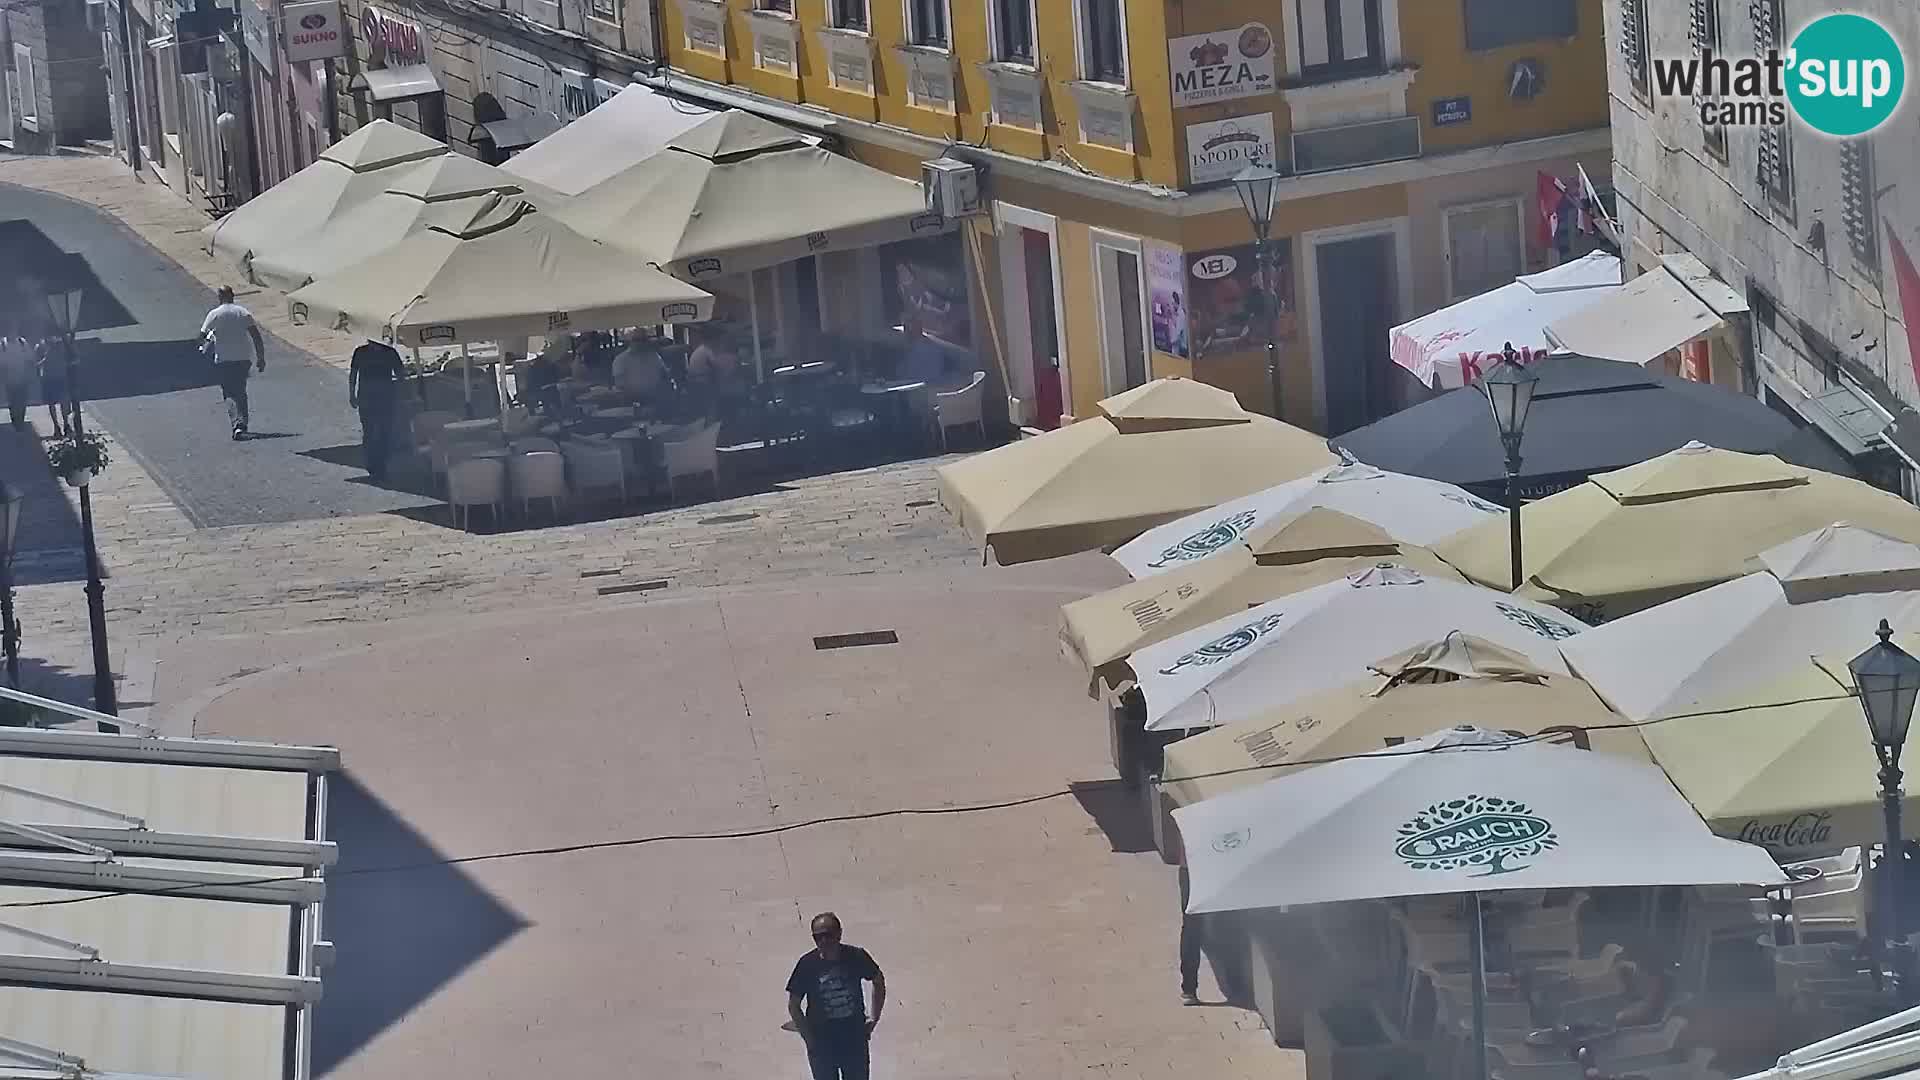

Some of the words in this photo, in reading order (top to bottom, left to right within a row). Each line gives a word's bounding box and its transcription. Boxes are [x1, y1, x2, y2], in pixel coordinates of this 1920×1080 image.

[293, 31, 337, 45] SUKNO
[1175, 62, 1254, 93] MEZA
[1192, 148, 1239, 166] ISPOD
[1435, 821, 1533, 850] RAUCH
